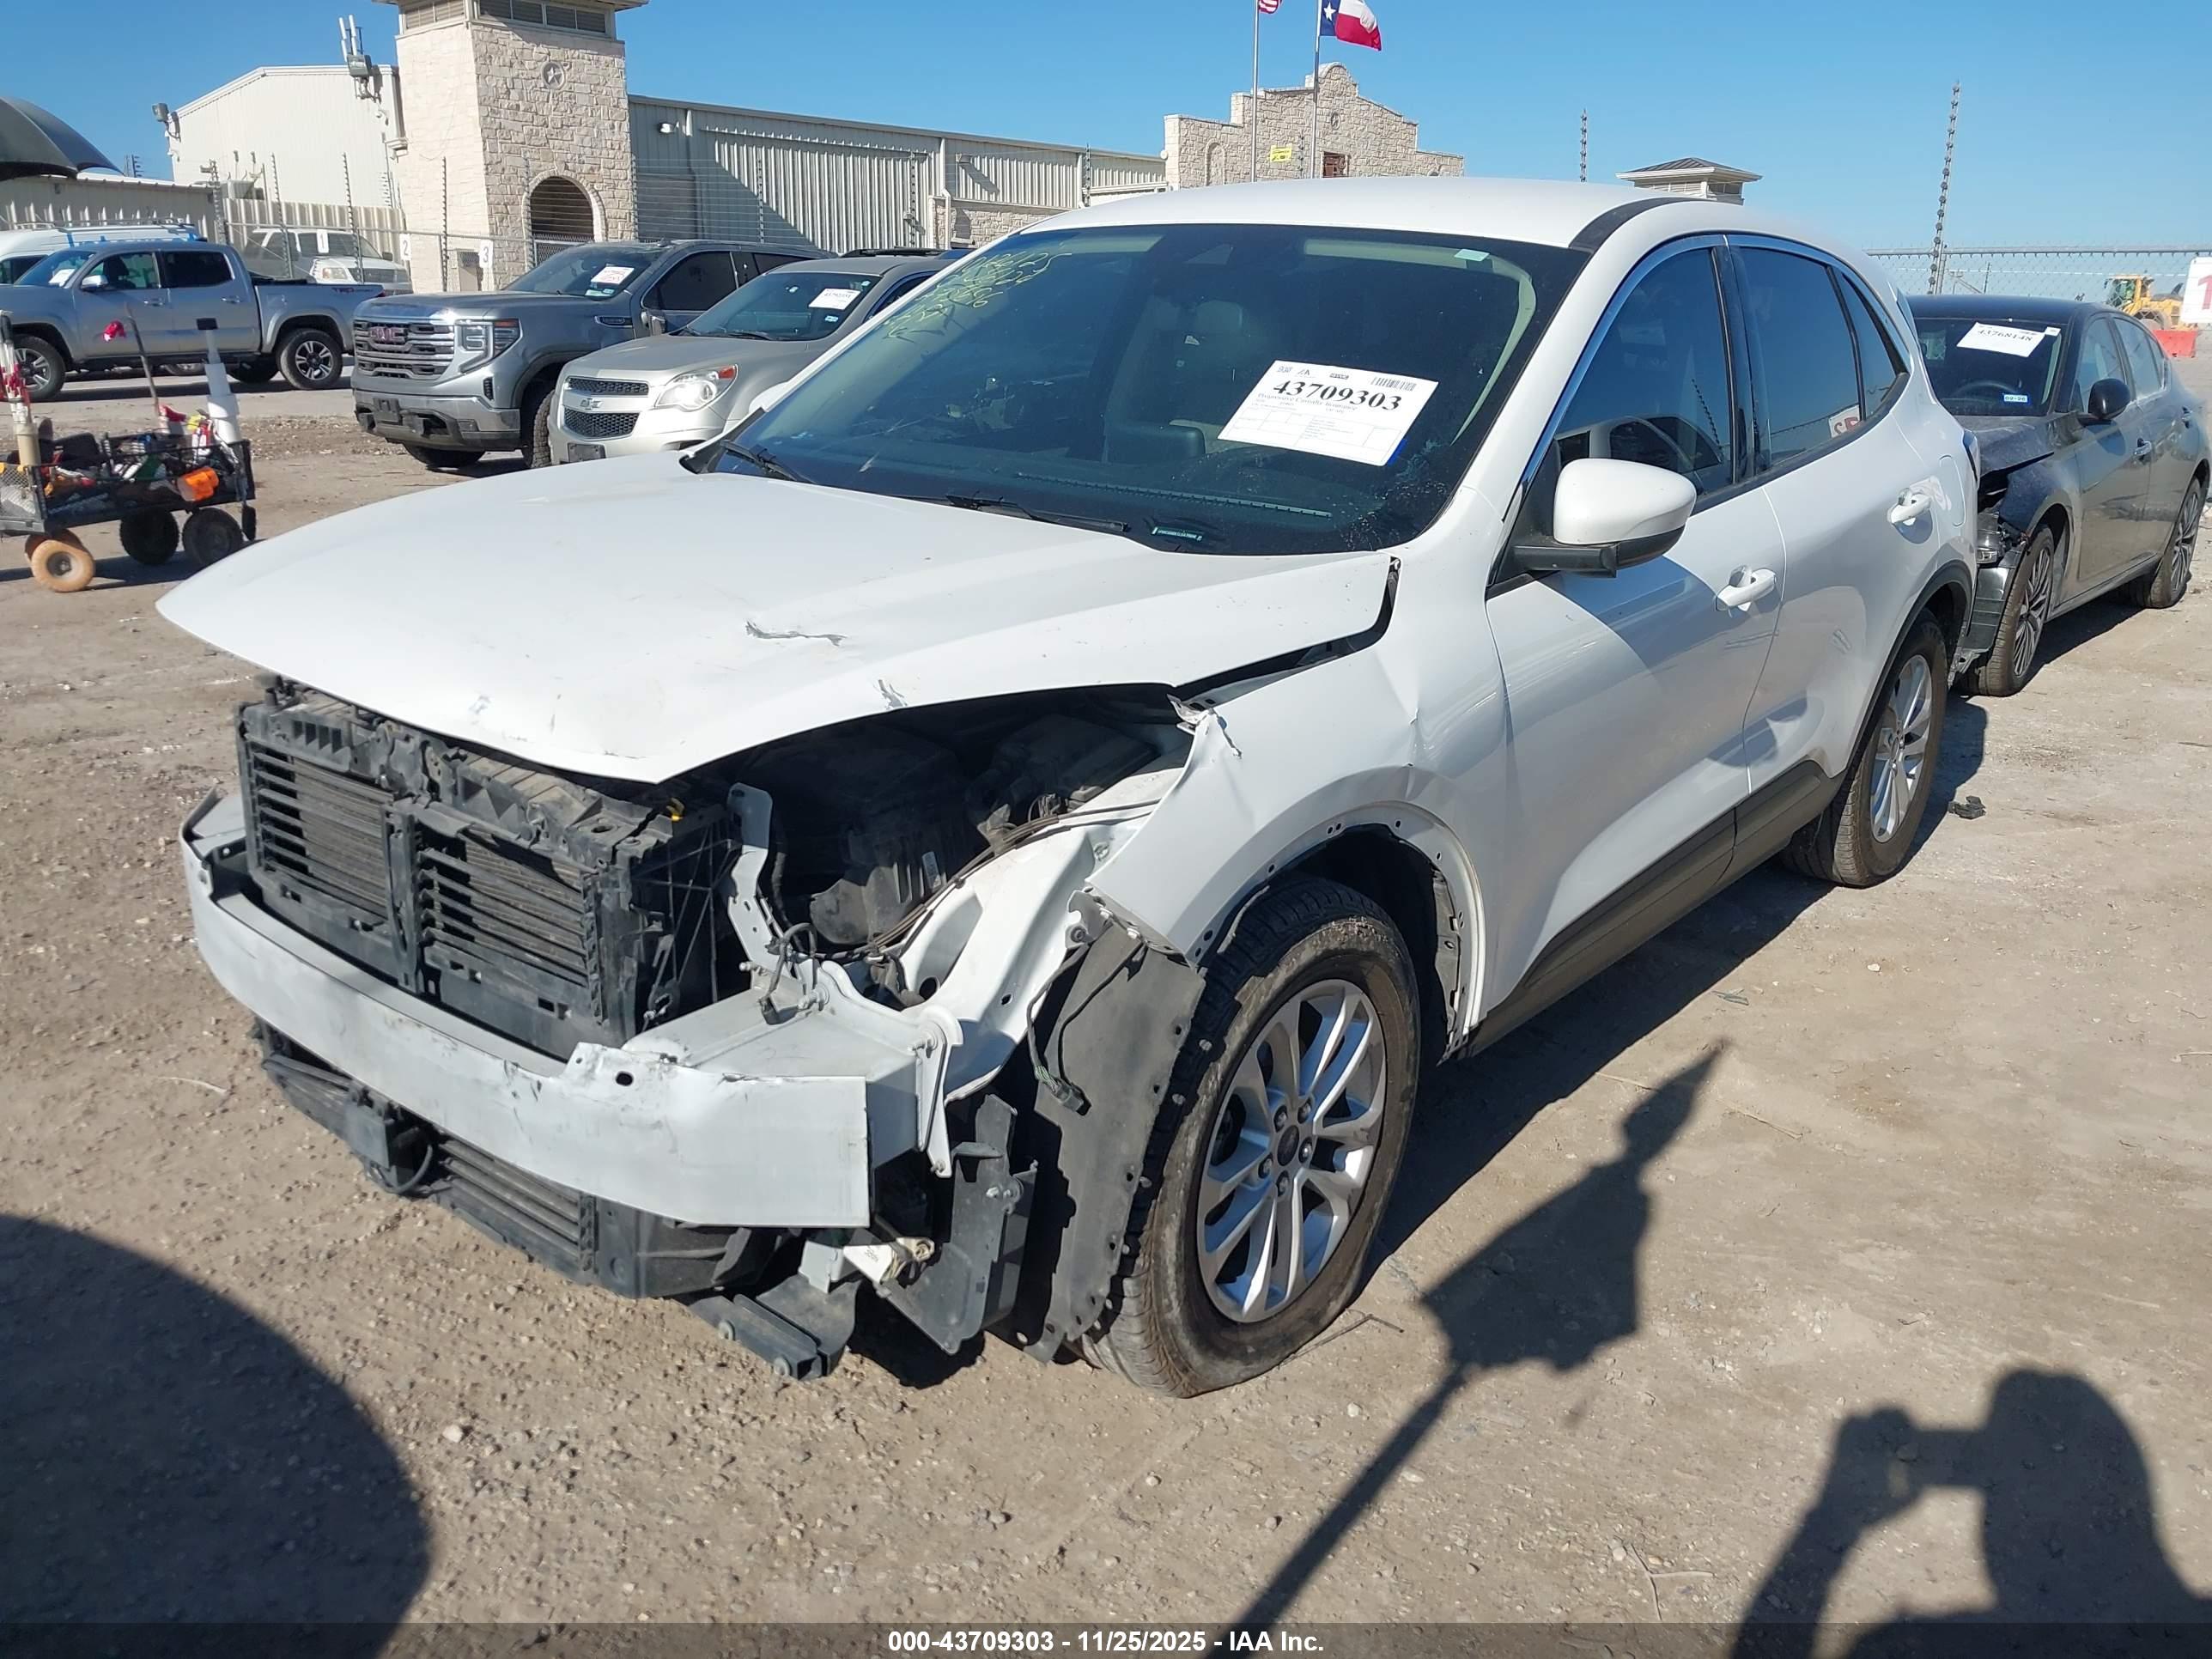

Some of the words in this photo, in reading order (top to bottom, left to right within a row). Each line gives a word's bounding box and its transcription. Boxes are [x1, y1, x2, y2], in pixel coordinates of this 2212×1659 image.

[403, 240, 409, 256] 2
[483, 246, 489, 263] 3
[370, 326, 404, 343] GMC
[1978, 329, 2033, 341] 43768148
[1273, 380, 1402, 411] 43709303
